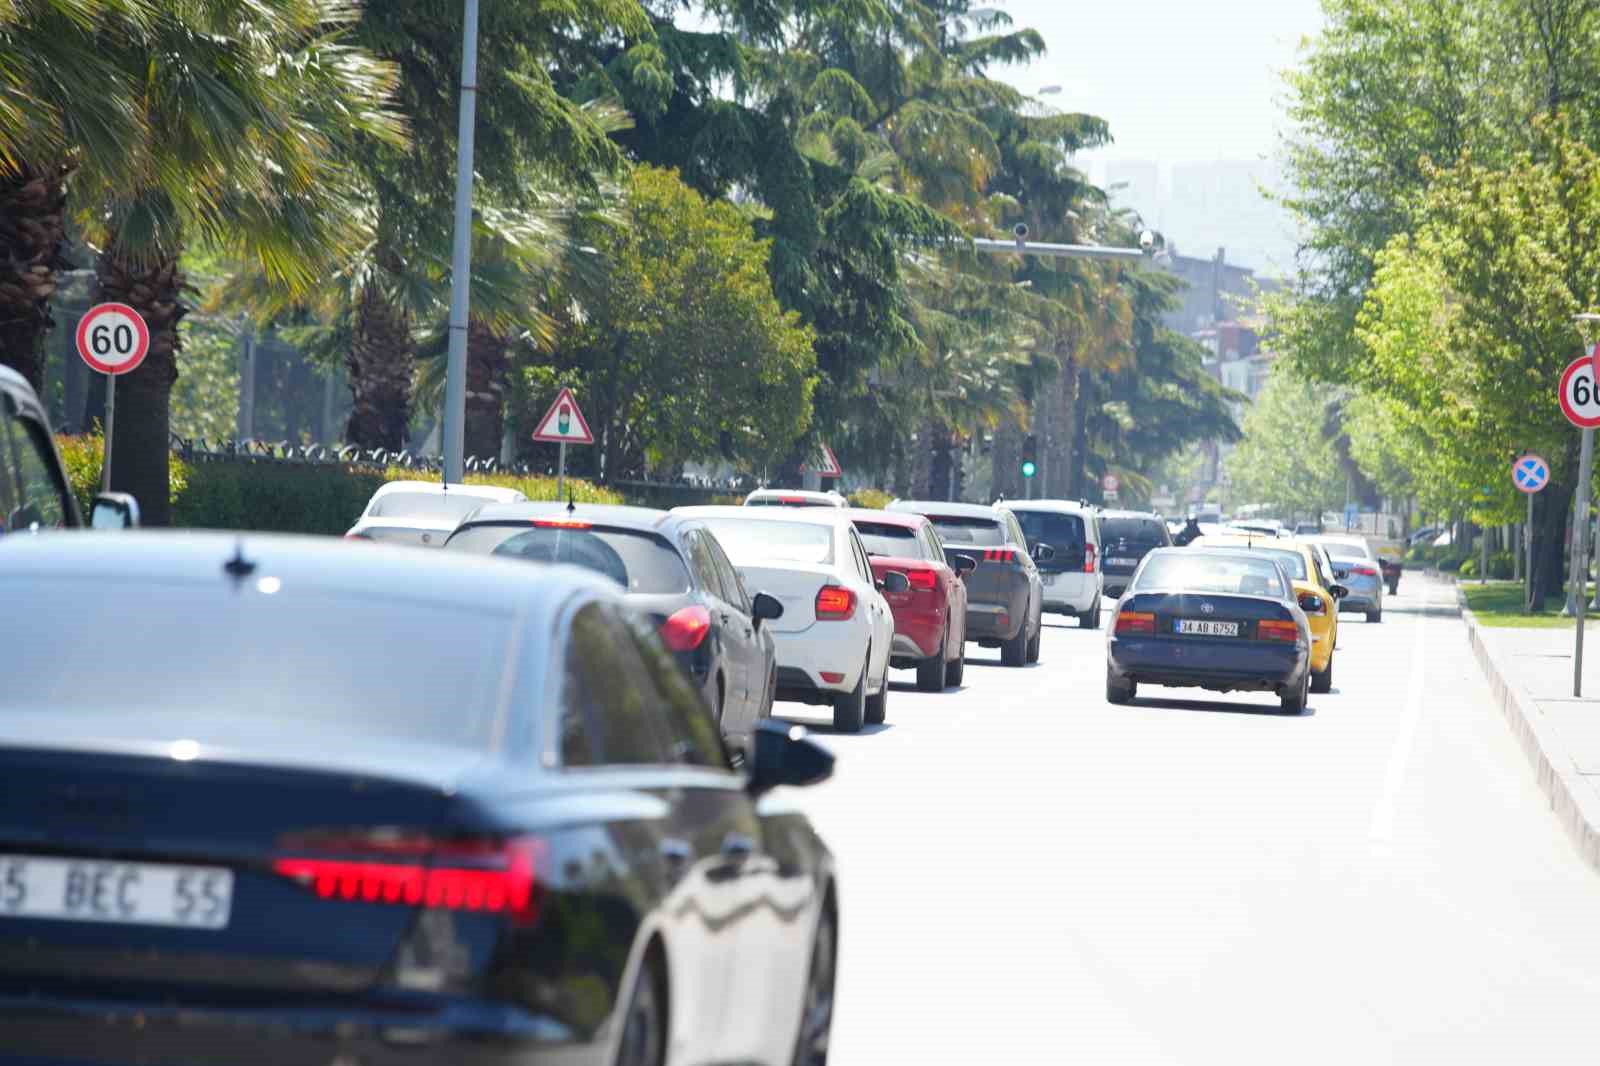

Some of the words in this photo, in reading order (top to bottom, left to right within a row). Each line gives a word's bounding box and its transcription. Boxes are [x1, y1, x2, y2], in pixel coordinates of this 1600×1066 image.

[92, 325, 132, 355] 60
[1181, 622, 1192, 633] 34
[0, 863, 27, 909] 5
[175, 870, 221, 917] 55
